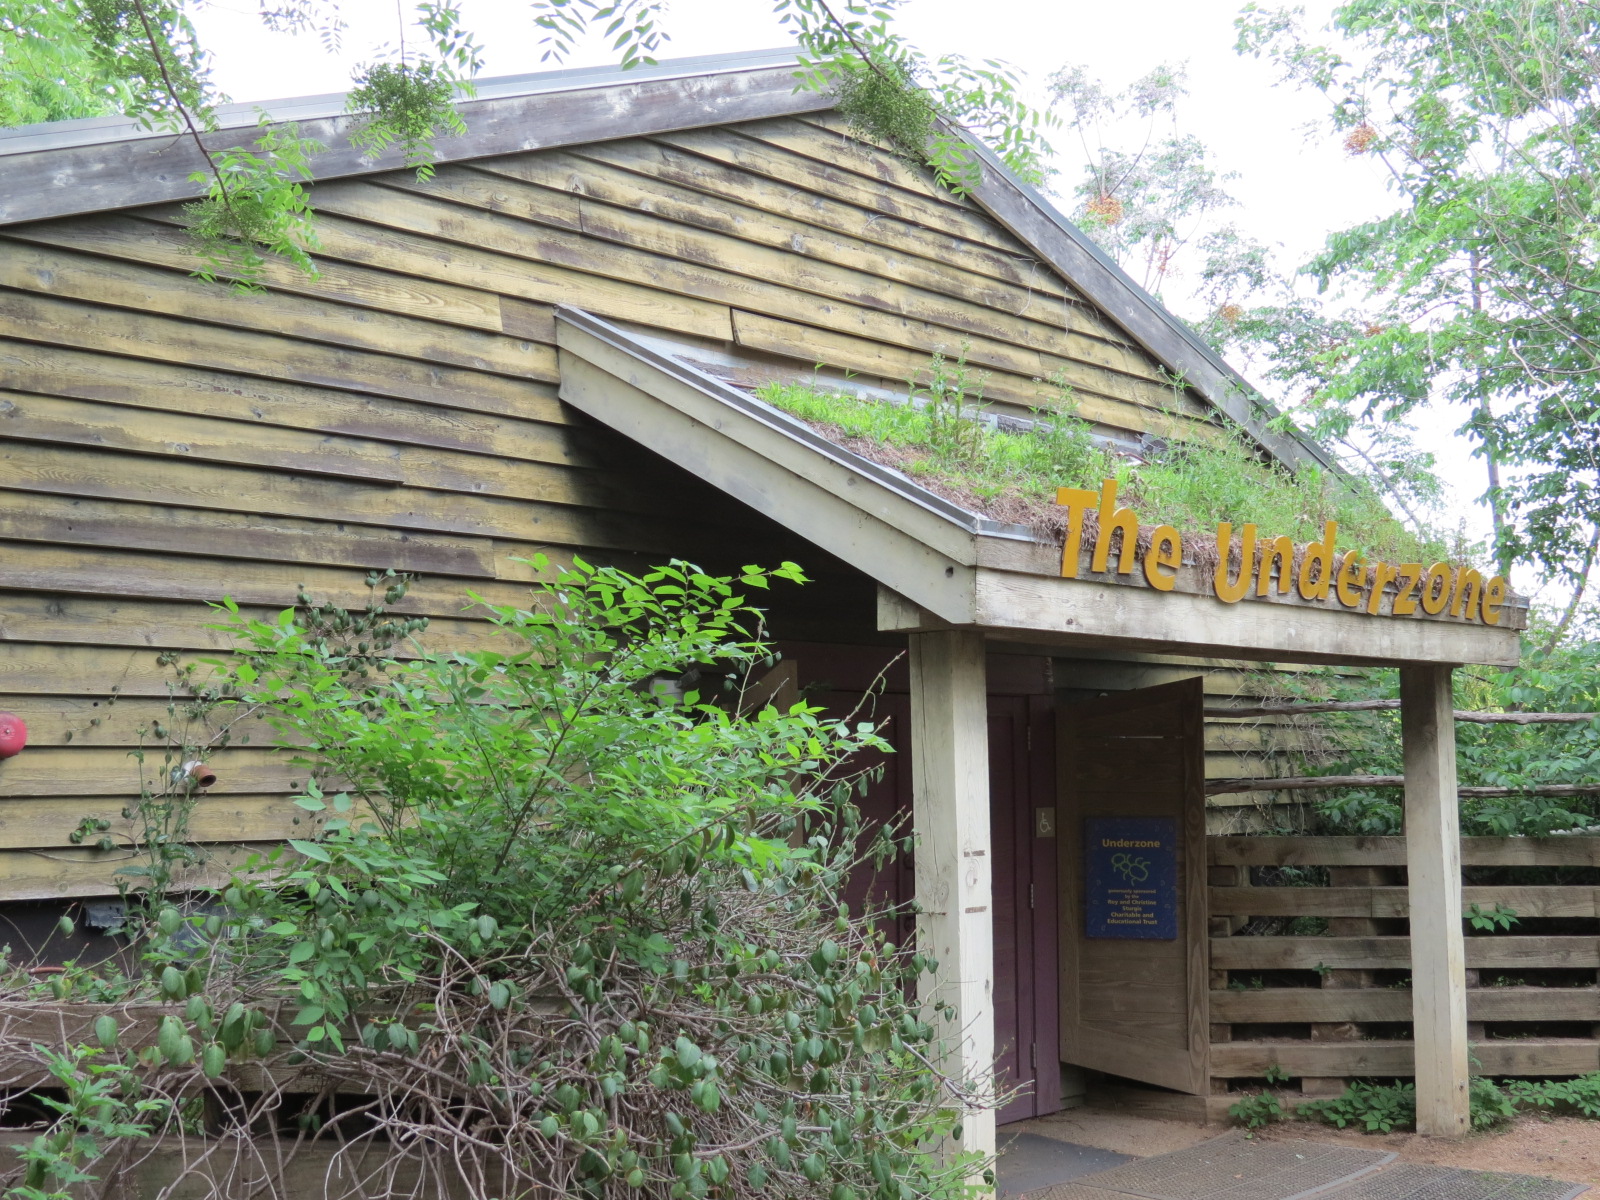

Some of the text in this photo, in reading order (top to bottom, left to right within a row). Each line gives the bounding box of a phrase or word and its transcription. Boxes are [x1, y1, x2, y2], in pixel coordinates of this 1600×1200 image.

[1056, 478, 1506, 625] The Underzone
[1102, 838, 1161, 848] Underzone
